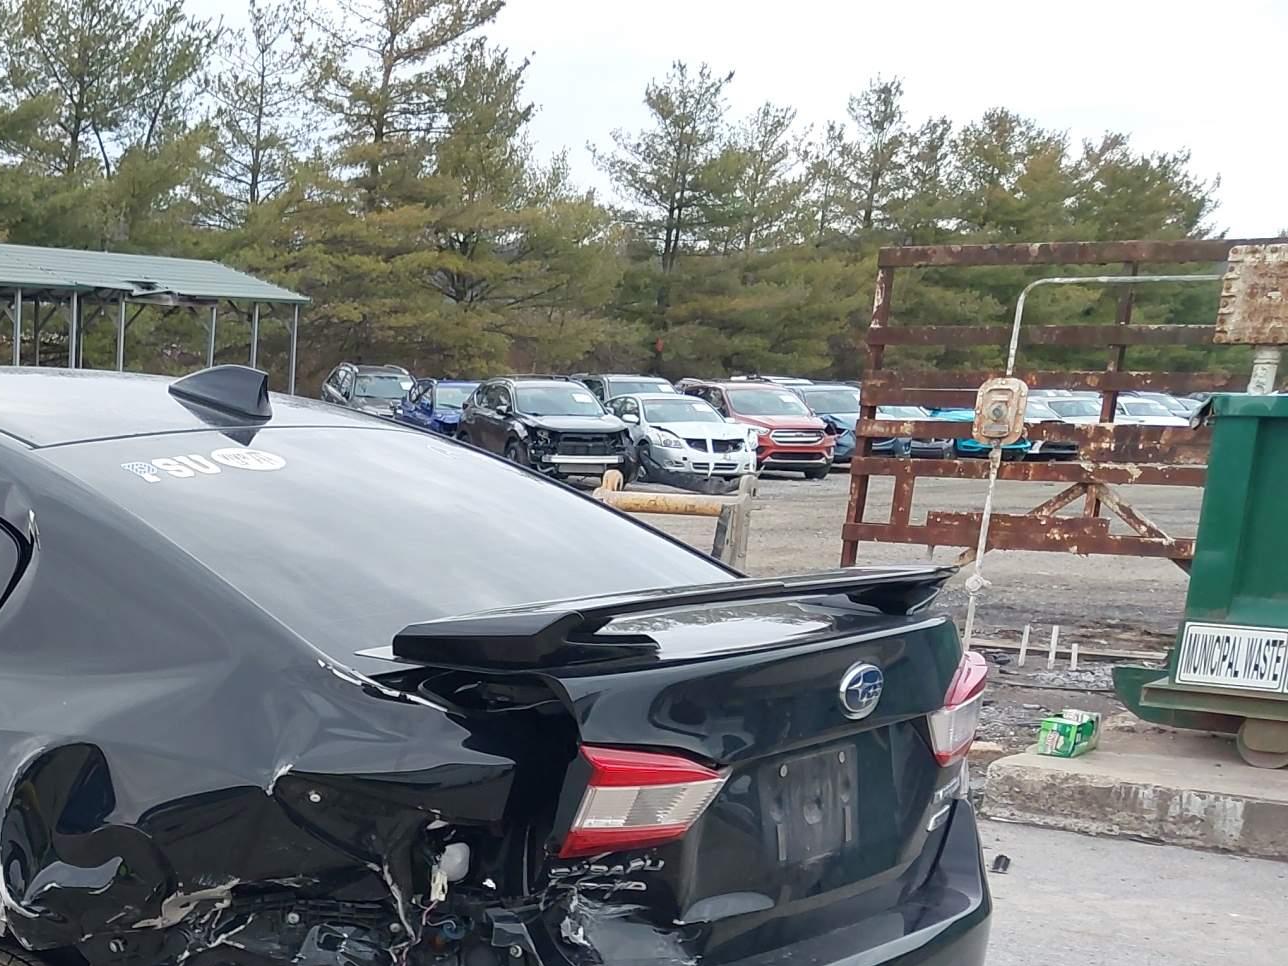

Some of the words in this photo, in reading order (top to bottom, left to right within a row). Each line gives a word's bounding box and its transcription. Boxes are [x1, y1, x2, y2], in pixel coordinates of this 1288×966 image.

[1182, 632, 1242, 678] MUNICIPAL
[1242, 637, 1285, 682] WASTE
[548, 856, 665, 879] SUBARU
